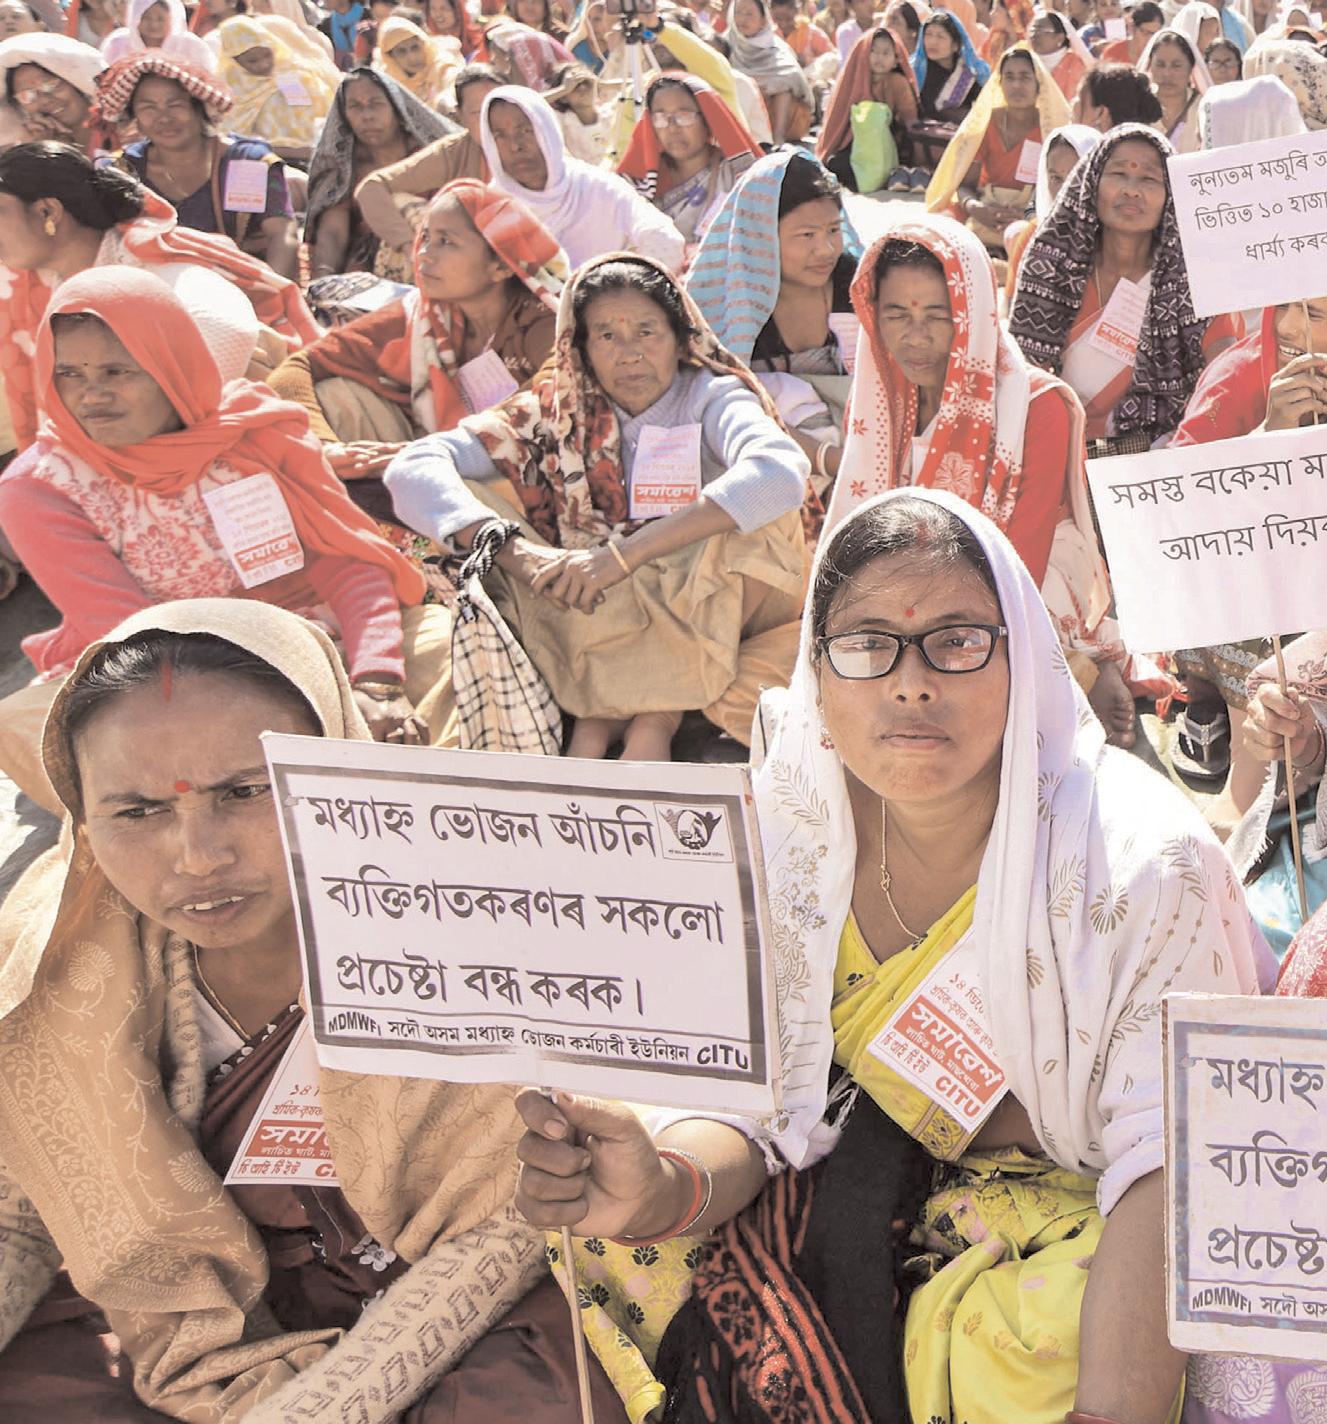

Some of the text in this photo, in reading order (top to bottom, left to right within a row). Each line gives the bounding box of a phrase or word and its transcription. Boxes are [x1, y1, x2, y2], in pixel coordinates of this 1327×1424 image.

[1195, 203, 1253, 231] ভিত্তিত
[1261, 203, 1283, 219] ১০
[1109, 474, 1184, 509] সমস্ত
[1191, 459, 1293, 497] বকেয়া
[1160, 526, 1255, 562] আদায়
[308, 796, 656, 857] মধ্যাহ্ন ভোজন আঁচনি
[596, 894, 724, 944] সকলো
[459, 963, 524, 1007] বন্ধ
[949, 973, 966, 990] ১৪
[388, 1019, 420, 1040] সদৌ
[426, 1026, 460, 1044] অসম
[465, 1026, 515, 1047] মধ্যাহ্ন
[628, 1037, 690, 1064] ইউনিয়ন
[697, 1044, 749, 1071] CITU
[290, 1084, 311, 1096] ১৪
[935, 1077, 981, 1117] CITU
[1208, 1056, 1327, 1111] মধ্যাহ্ন
[1259, 1293, 1297, 1318] সদৌ
